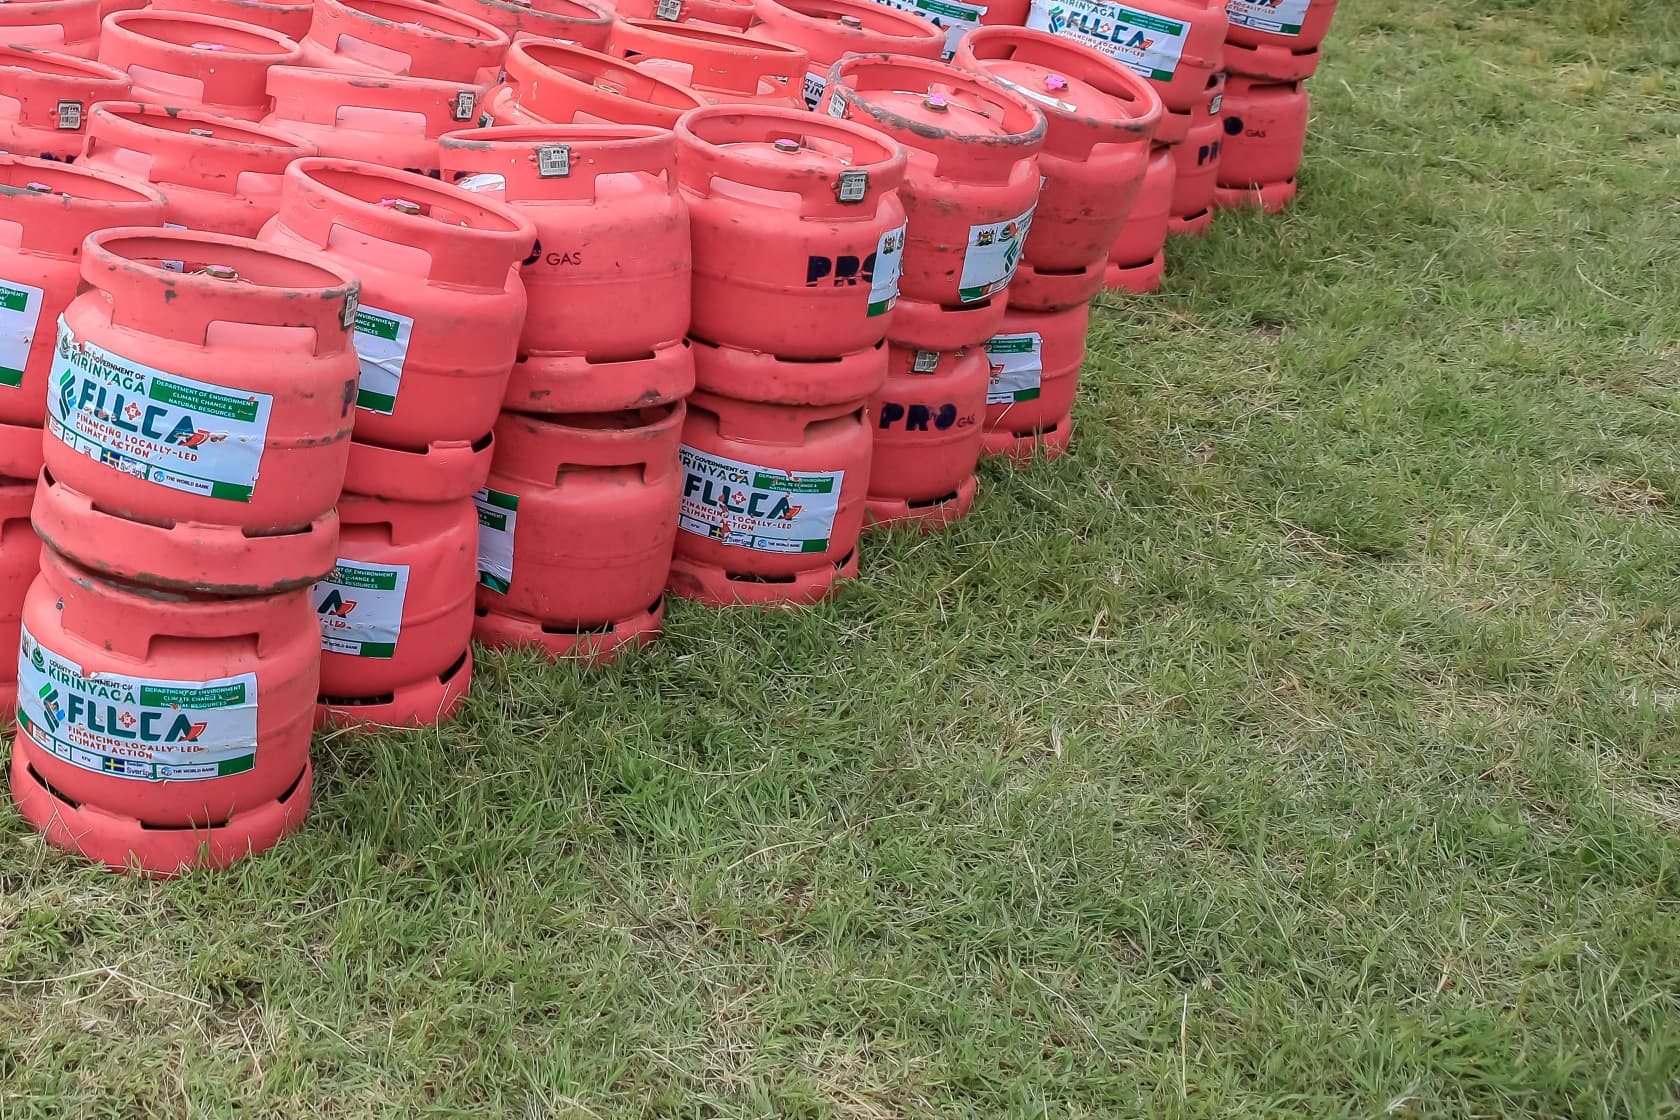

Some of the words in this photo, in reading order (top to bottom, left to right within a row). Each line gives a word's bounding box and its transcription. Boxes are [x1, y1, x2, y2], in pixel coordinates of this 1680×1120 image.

[1245, 129, 1266, 137] GAS
[546, 252, 582, 266] GAS
[70, 352, 146, 396] KIRINYAGA
[135, 373, 146, 381] OF
[156, 380, 197, 396] DEPARTMENT
[208, 393, 255, 408] ENVIRONMENT
[172, 392, 199, 405] CLIMATE
[200, 398, 227, 410] CHANGE
[169, 398, 197, 412] NATURAL
[197, 404, 236, 418] RESOURCES
[879, 402, 957, 431] PRO
[76, 413, 122, 439] FINANCING
[125, 434, 198, 462] LOCALLY-LED
[76, 421, 107, 443] CLIMATE
[110, 439, 150, 458] ACTION
[679, 455, 749, 486] RINYAGA
[694, 453, 739, 473] GOVERNMENT
[681, 506, 716, 522] CLIMATE
[719, 519, 755, 531] ACTION
[732, 515, 792, 529] LOCALLY-LED
[68, 726, 122, 747] FINANCING
[111, 746, 153, 760] ACTION
